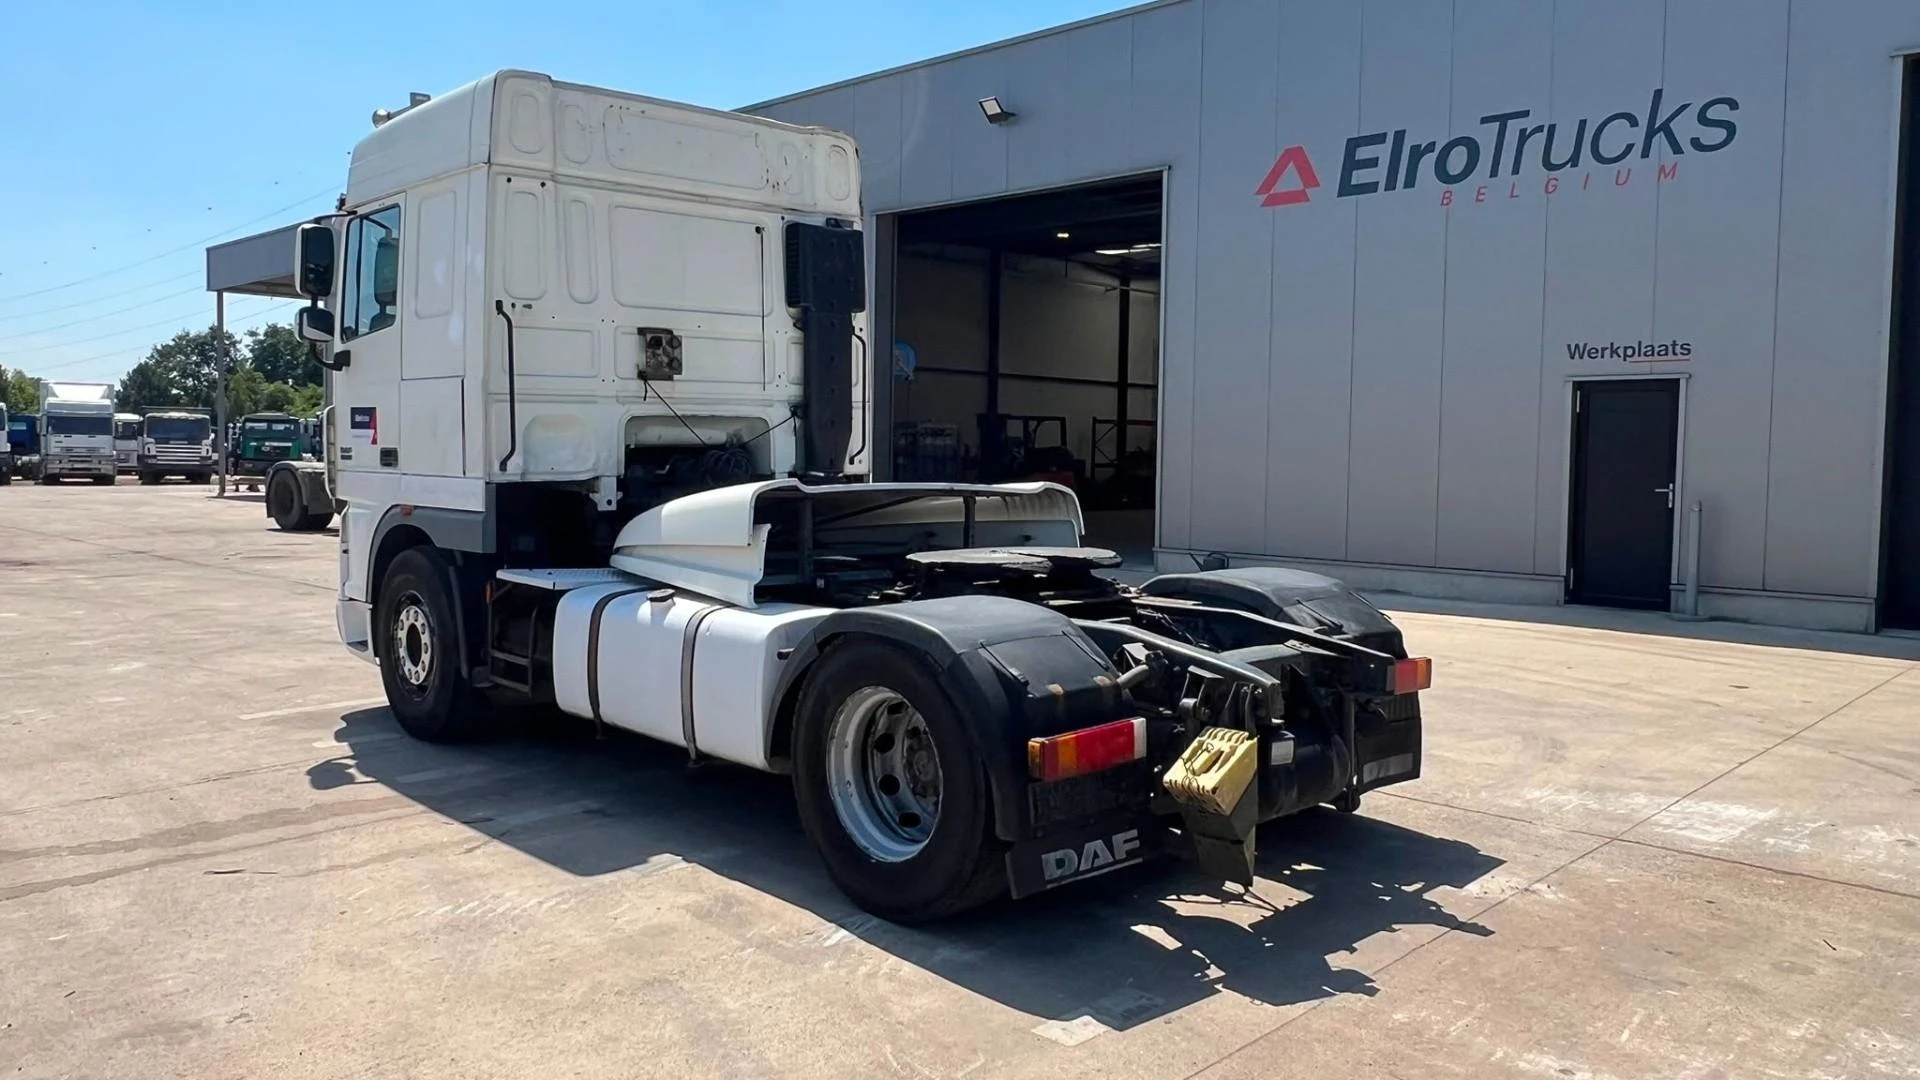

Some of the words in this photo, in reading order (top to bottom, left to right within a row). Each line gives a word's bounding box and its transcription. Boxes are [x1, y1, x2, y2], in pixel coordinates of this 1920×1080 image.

[1337, 88, 1740, 198] ElroTrucks
[1567, 340, 1692, 362] Werkplaats
[1041, 829, 1140, 880] DAF
